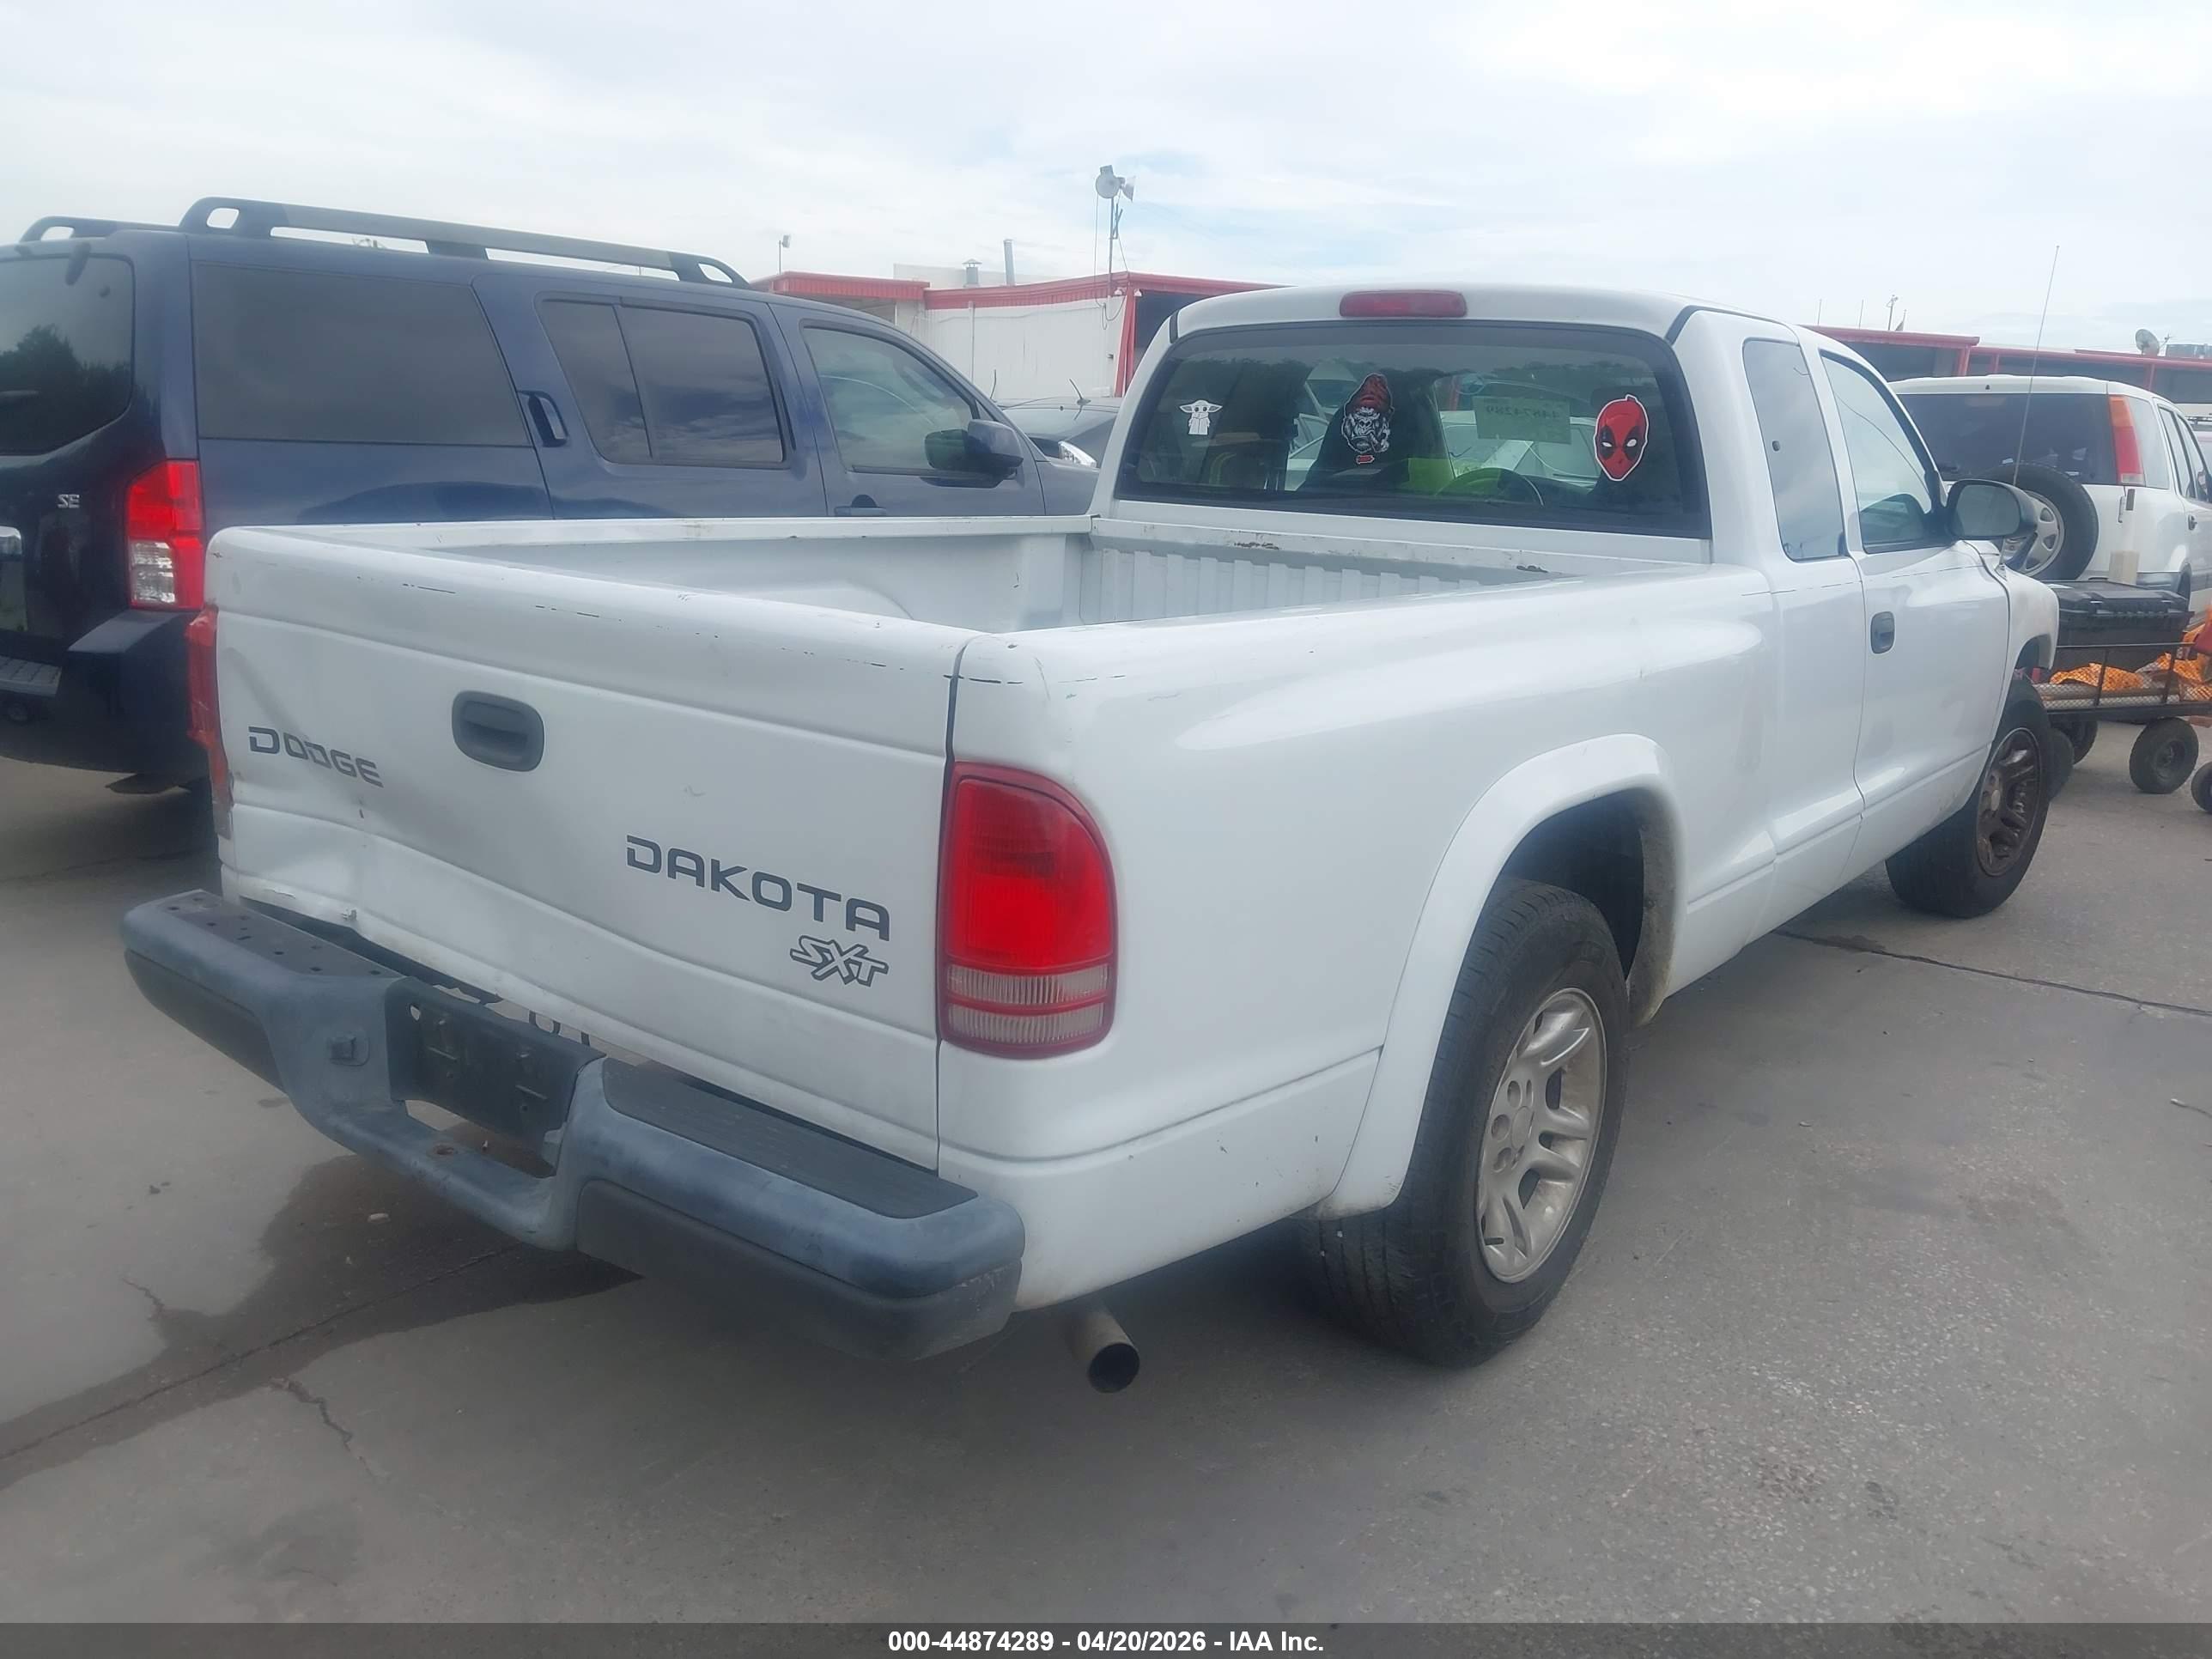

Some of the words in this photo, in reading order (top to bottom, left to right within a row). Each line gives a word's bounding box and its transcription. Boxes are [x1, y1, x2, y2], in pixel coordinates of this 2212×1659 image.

[58, 494, 80, 508] SE
[248, 726, 384, 787] DODGE
[626, 835, 890, 941] DAKOTA
[789, 934, 890, 988] SXT
